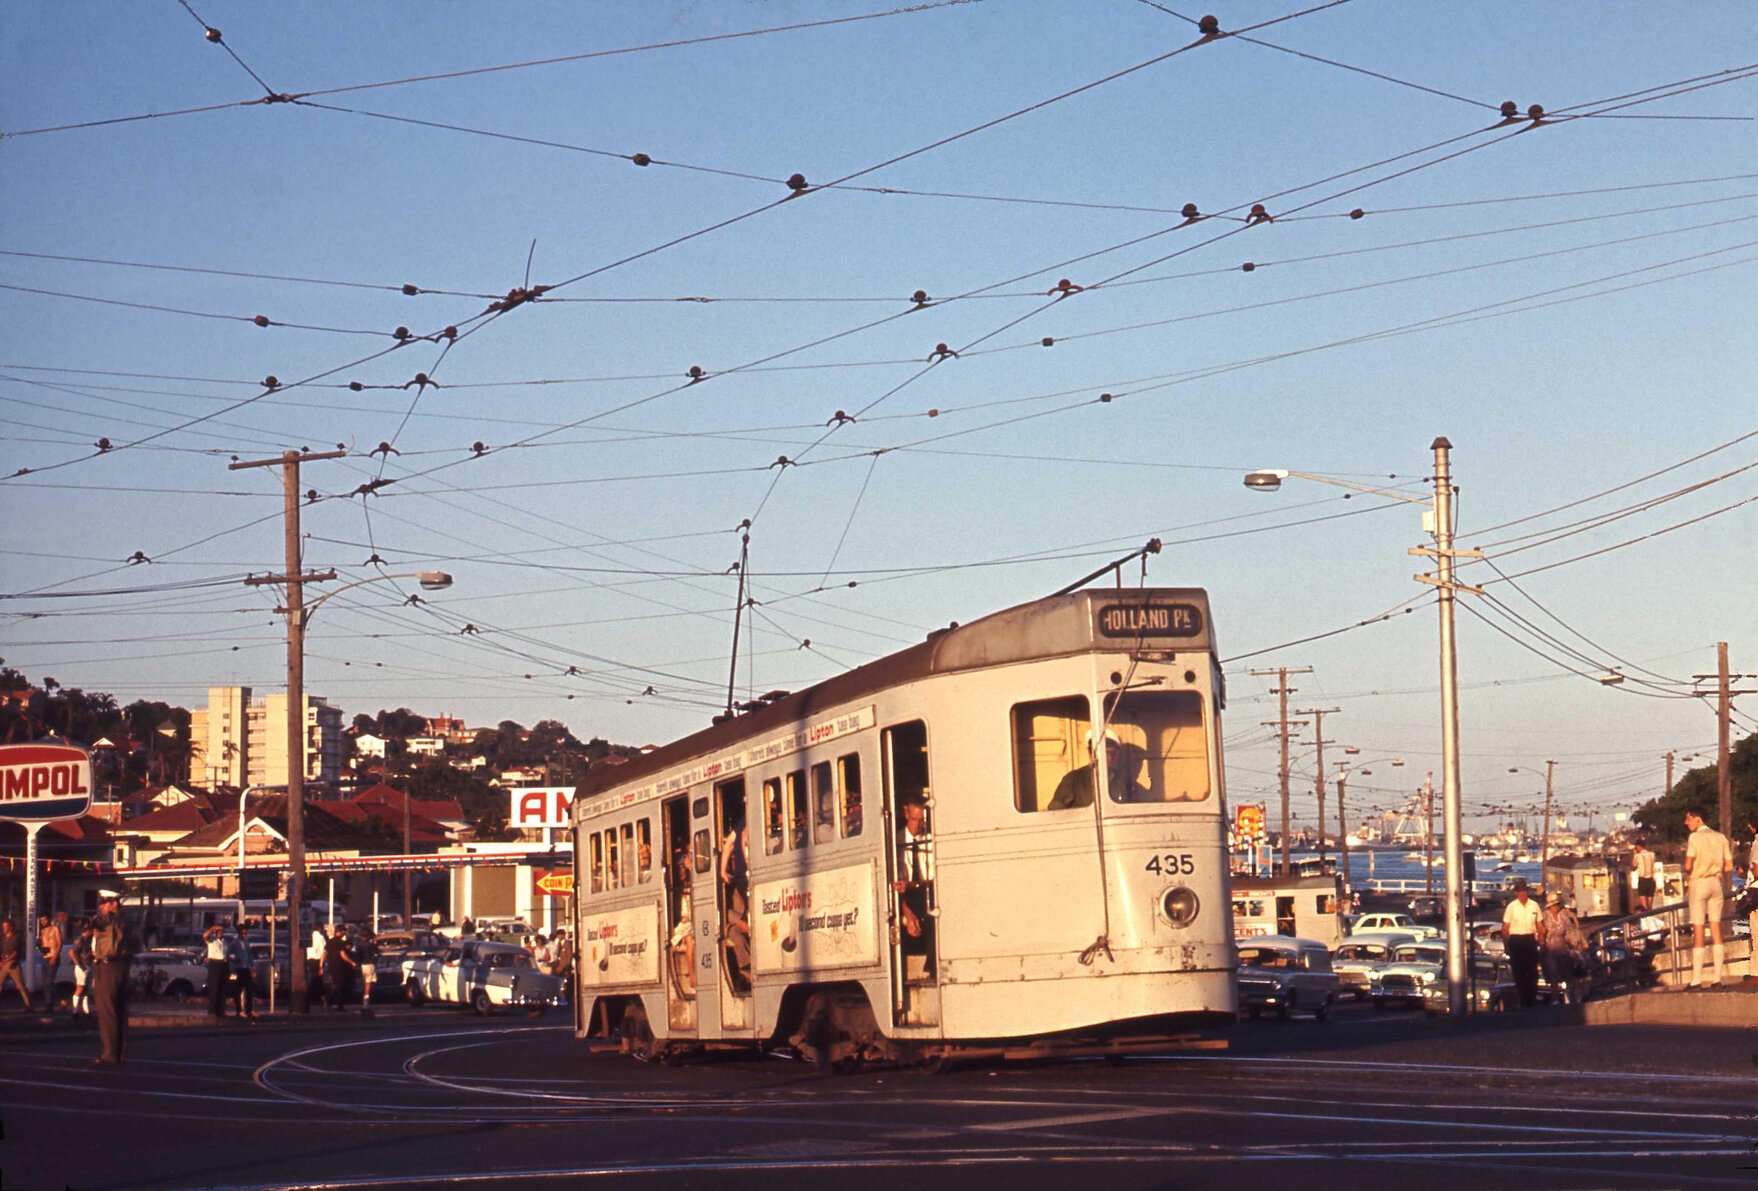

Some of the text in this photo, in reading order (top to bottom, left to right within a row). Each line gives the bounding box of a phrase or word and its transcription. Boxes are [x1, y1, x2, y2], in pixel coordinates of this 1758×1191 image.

[1105, 608, 1168, 630] HOLLAND
[809, 723, 834, 742] Lipton
[703, 762, 722, 779] Lipton
[0, 764, 87, 800] MPOL
[1145, 854, 1195, 876] 435
[543, 878, 562, 888] COIN
[762, 898, 780, 914] Tasted
[804, 912, 826, 931] second
[827, 914, 842, 932] cuppa
[844, 907, 859, 931] yet?
[701, 952, 712, 969] 435
